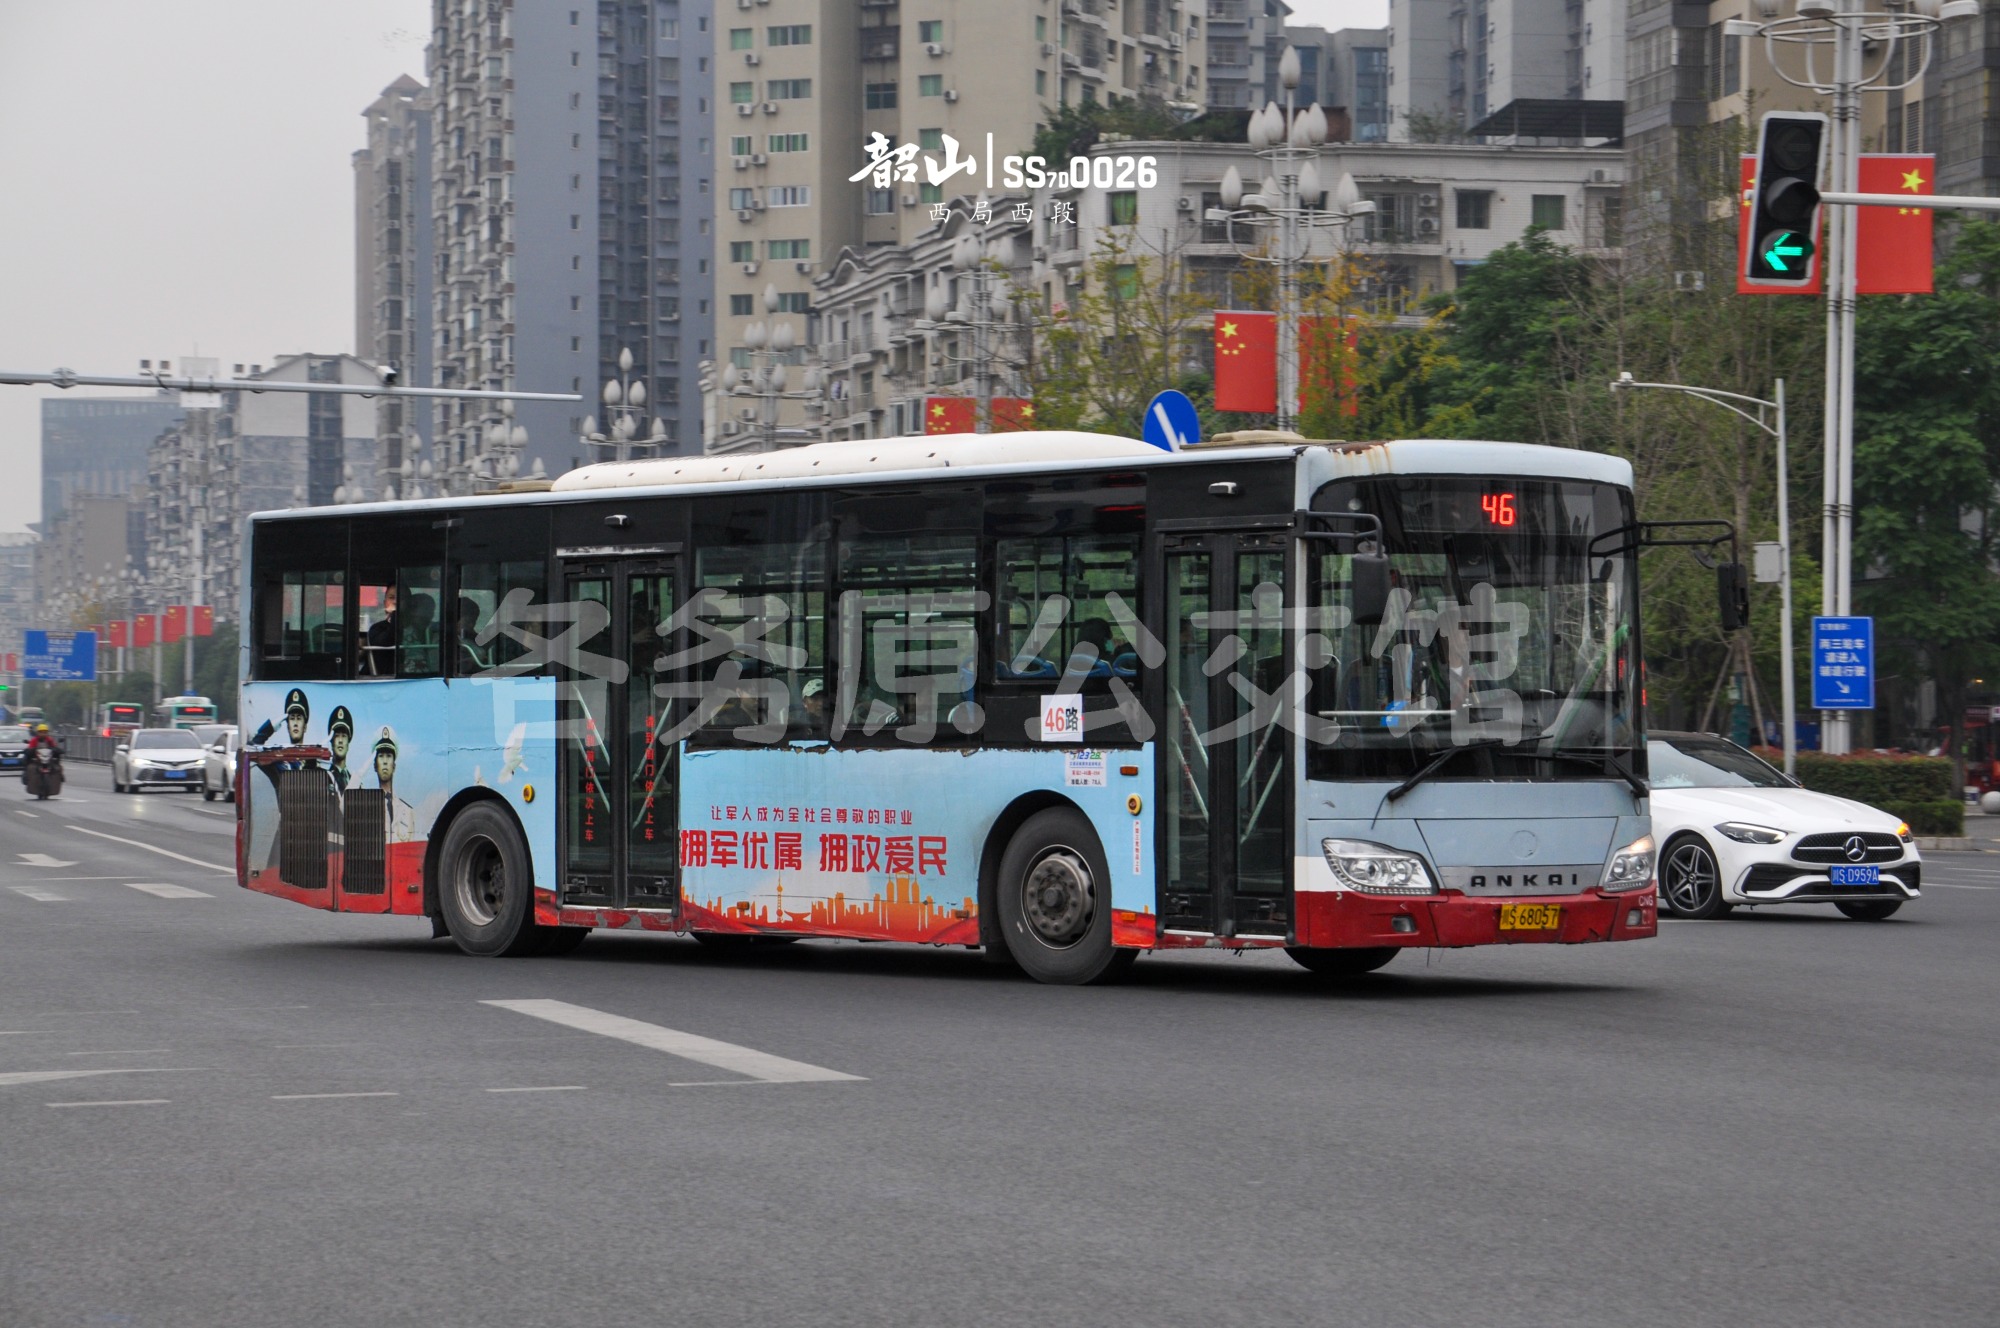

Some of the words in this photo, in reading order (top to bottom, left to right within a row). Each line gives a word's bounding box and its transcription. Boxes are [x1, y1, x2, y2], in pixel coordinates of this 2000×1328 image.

[1482, 493, 1515, 526] 46
[1045, 706, 1079, 732] 46路
[585, 718, 596, 842] 请到前门依次上车
[644, 715, 655, 841] 请到前门依次上车
[711, 805, 913, 825] 让军人成为全社会尊敬的职业
[680, 829, 802, 870] 拥军优属
[819, 833, 947, 876] 拥政爱民
[1470, 873, 1578, 888] ANKAI
